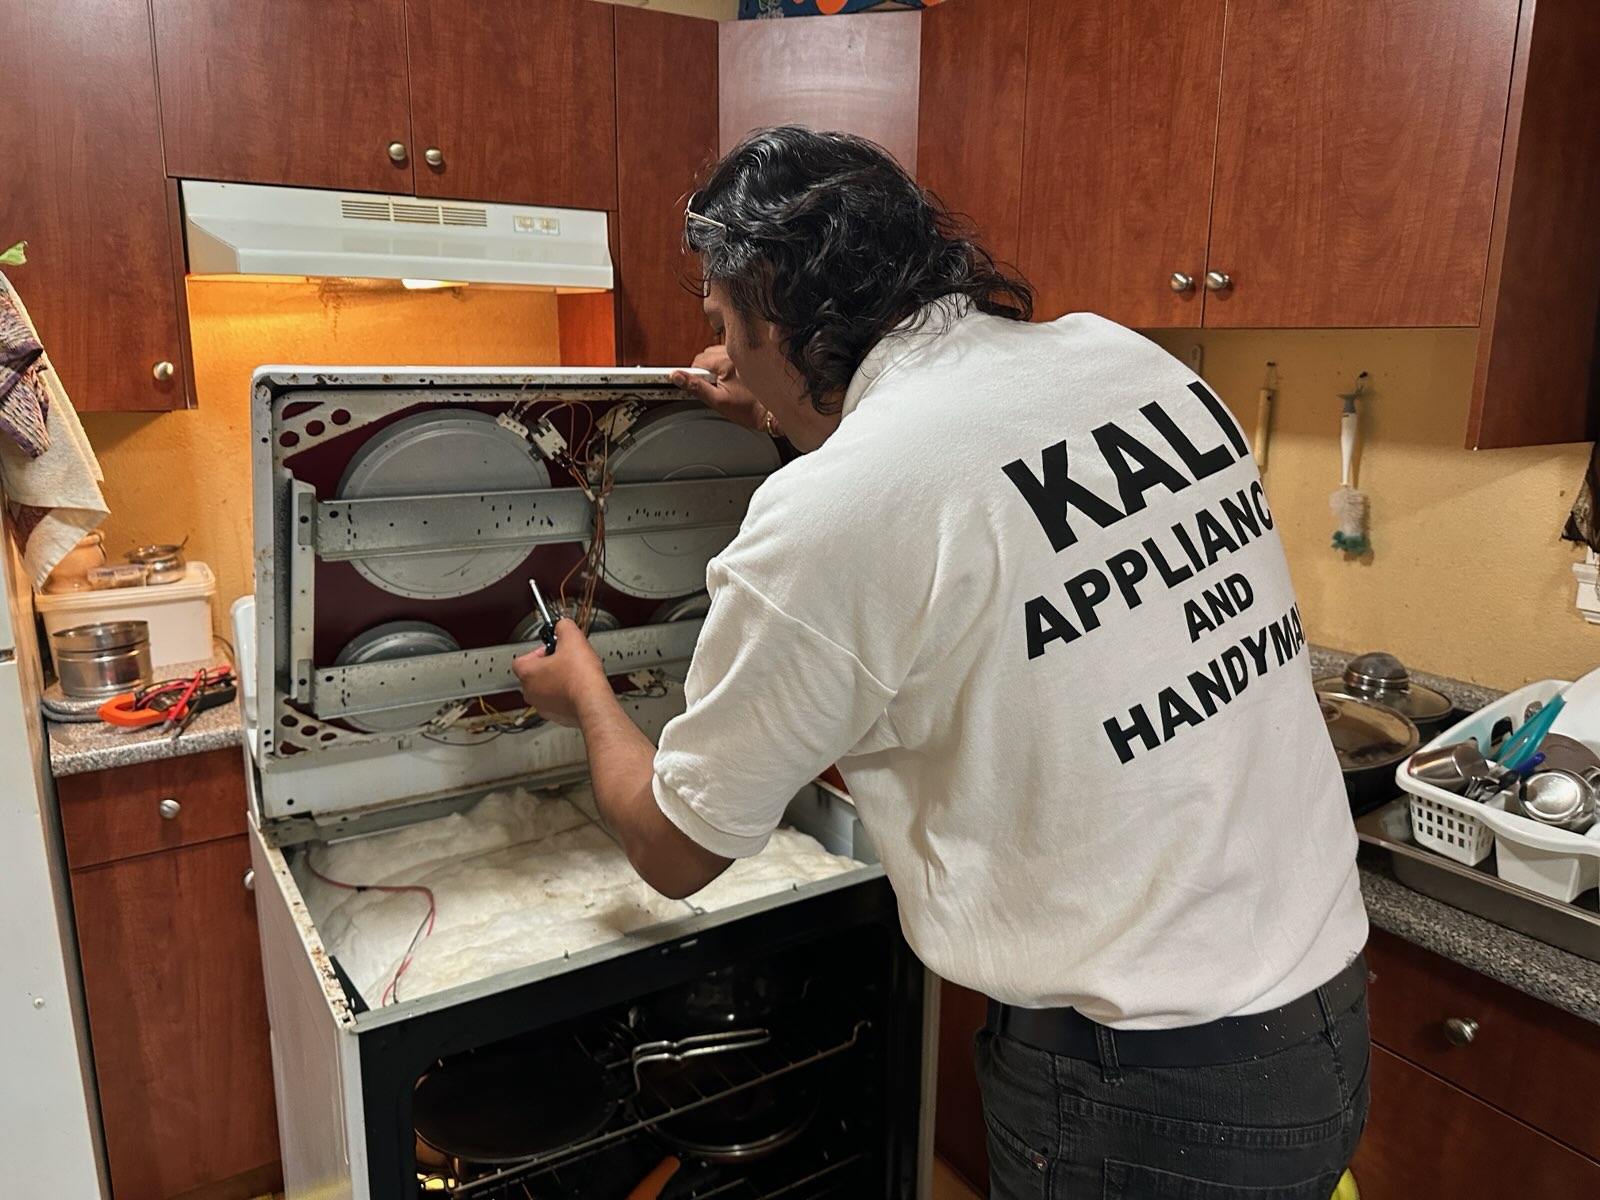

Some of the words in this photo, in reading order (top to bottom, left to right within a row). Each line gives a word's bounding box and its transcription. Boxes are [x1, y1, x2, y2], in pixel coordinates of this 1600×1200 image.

[1001, 381, 1249, 553] KALI
[1102, 602, 1306, 764] HANDYMA
[1183, 573, 1254, 643] AND
